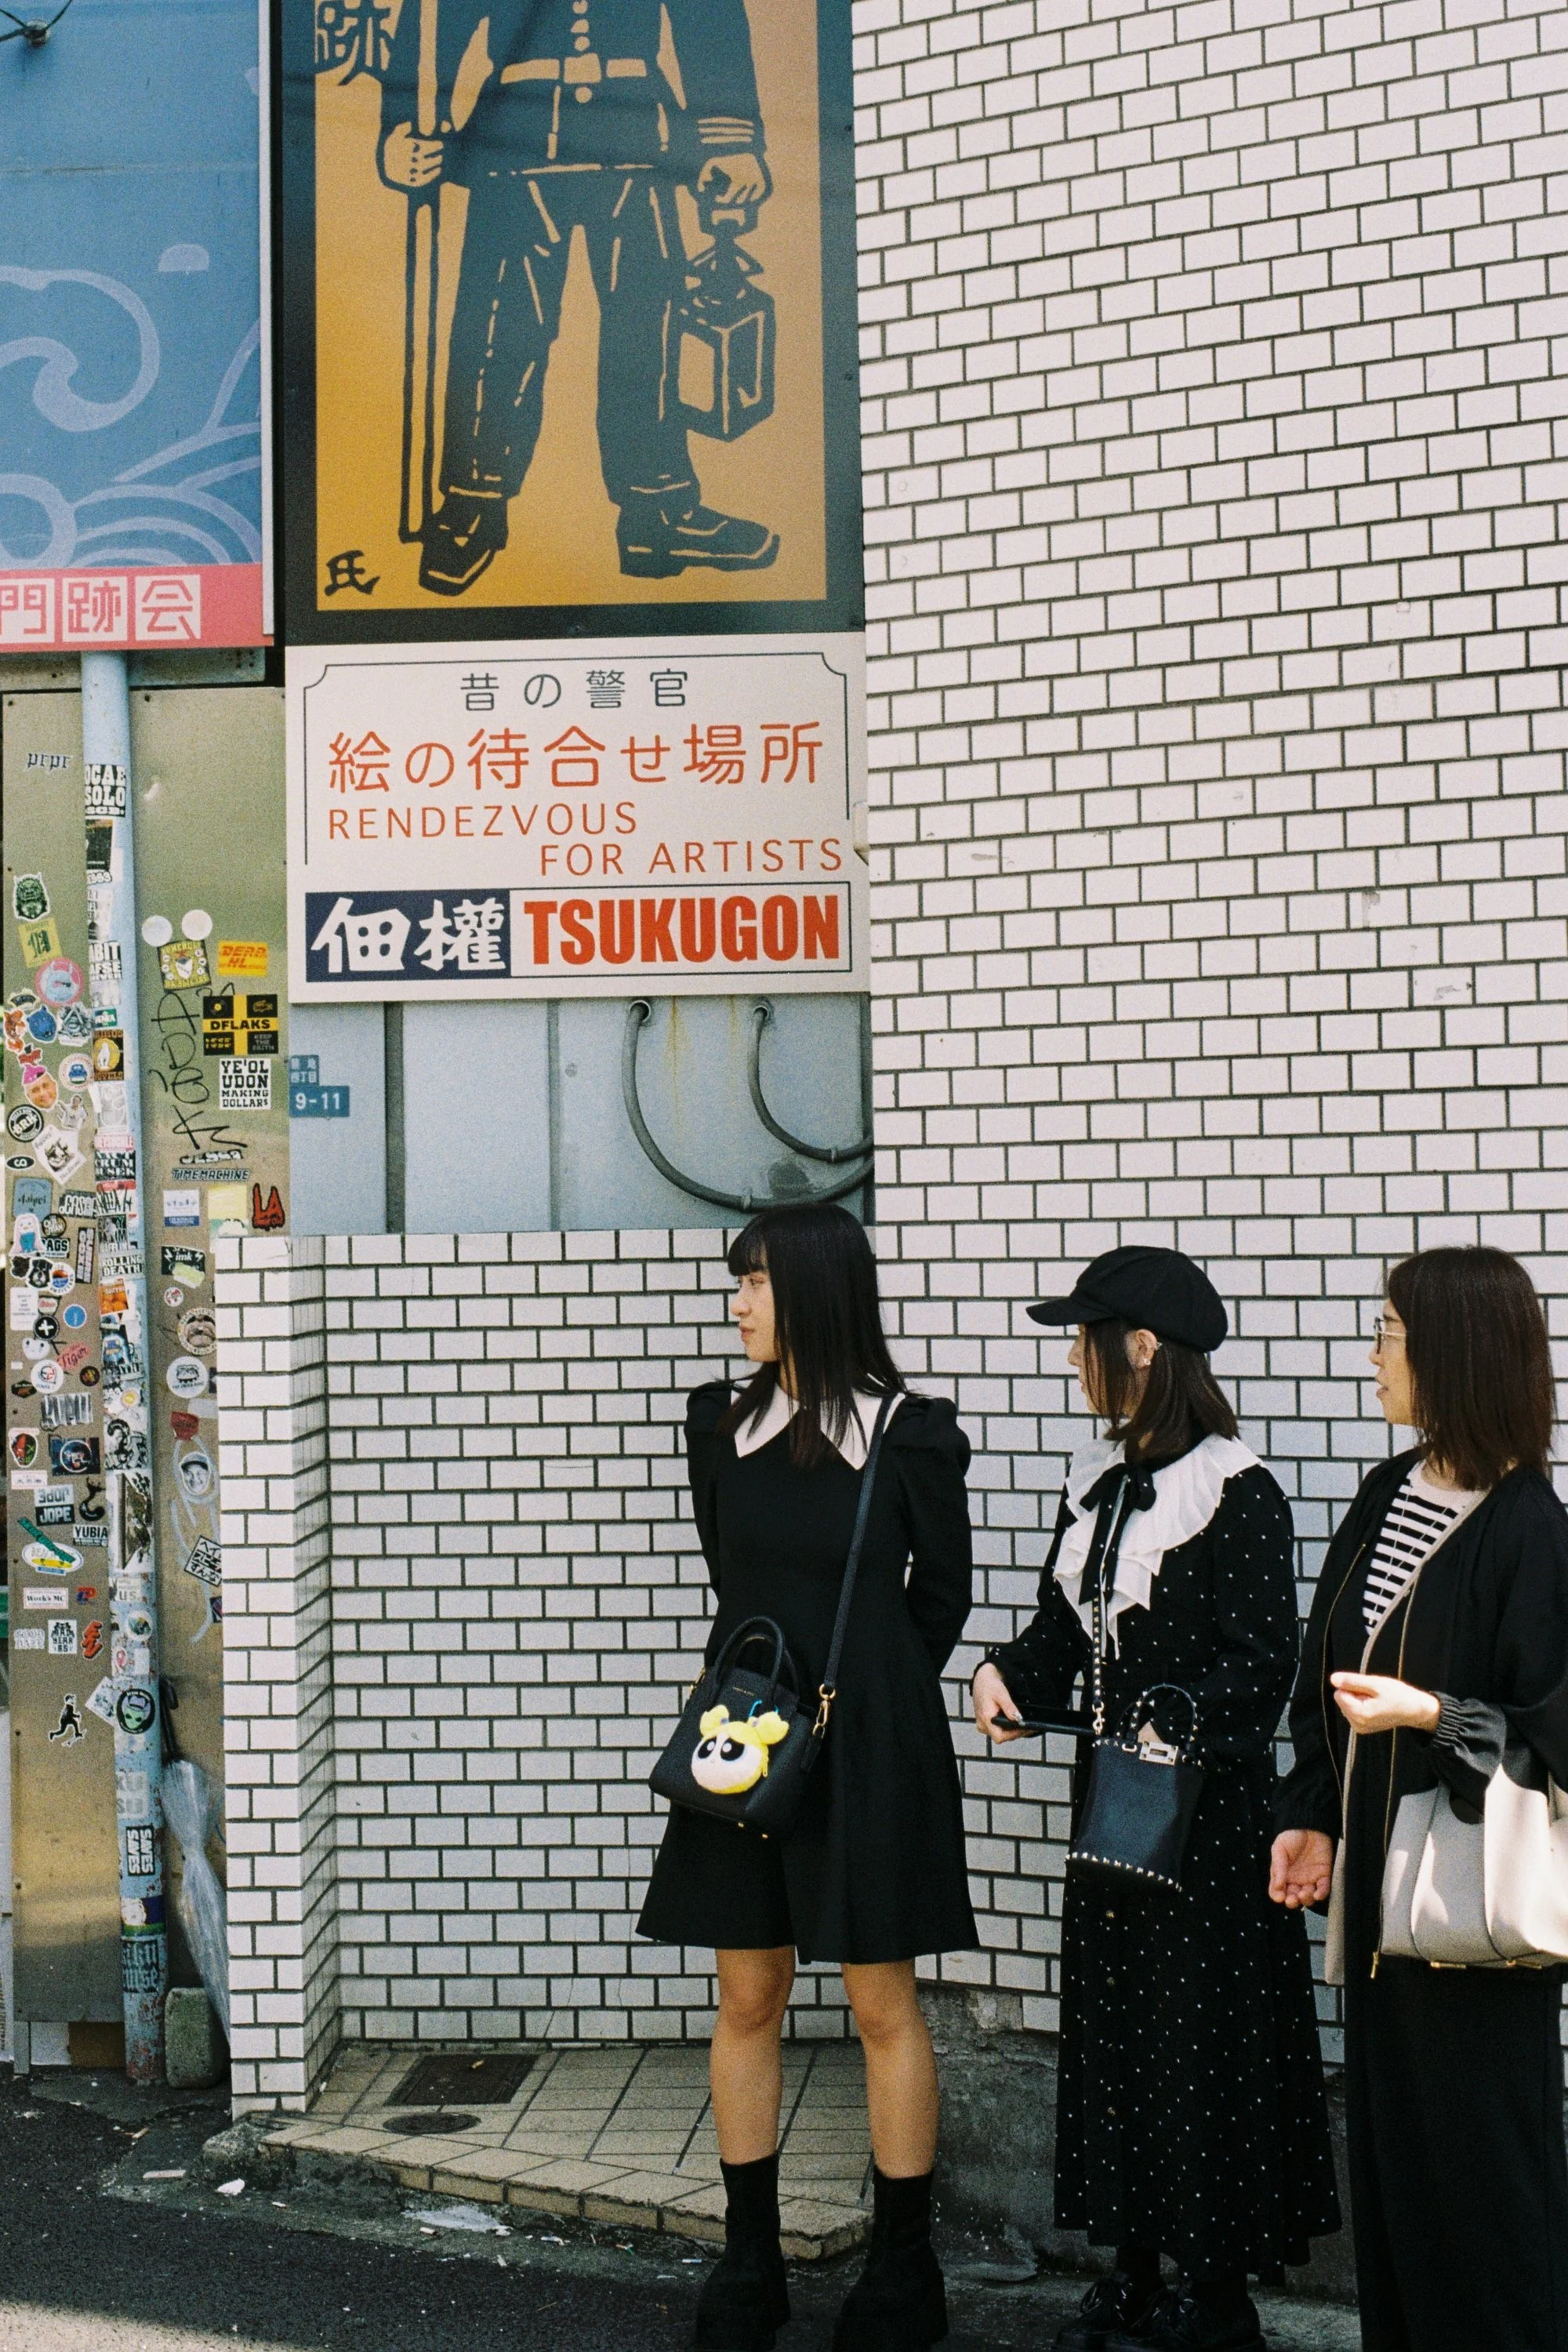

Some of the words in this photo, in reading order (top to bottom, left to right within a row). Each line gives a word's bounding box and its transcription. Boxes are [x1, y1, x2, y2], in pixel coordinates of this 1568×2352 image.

[460, 668, 688, 711] 昔の警官
[328, 720, 823, 794] 絵の待合せ場所
[329, 801, 637, 840] RENDEZVOUS
[541, 843, 624, 876] FOR
[648, 838, 842, 874] ARTISTS
[524, 895, 840, 965] TSUKUGON
[210, 1020, 270, 1030] DFLAKS
[221, 1059, 269, 1074] YE'OL
[222, 1075, 269, 1089] UDON
[296, 1092, 339, 1110] 9-11
[172, 1168, 249, 1181] TIMEMACHINE
[103, 1264, 142, 1276] DEATH
[39, 1506, 72, 1523] JOPE
